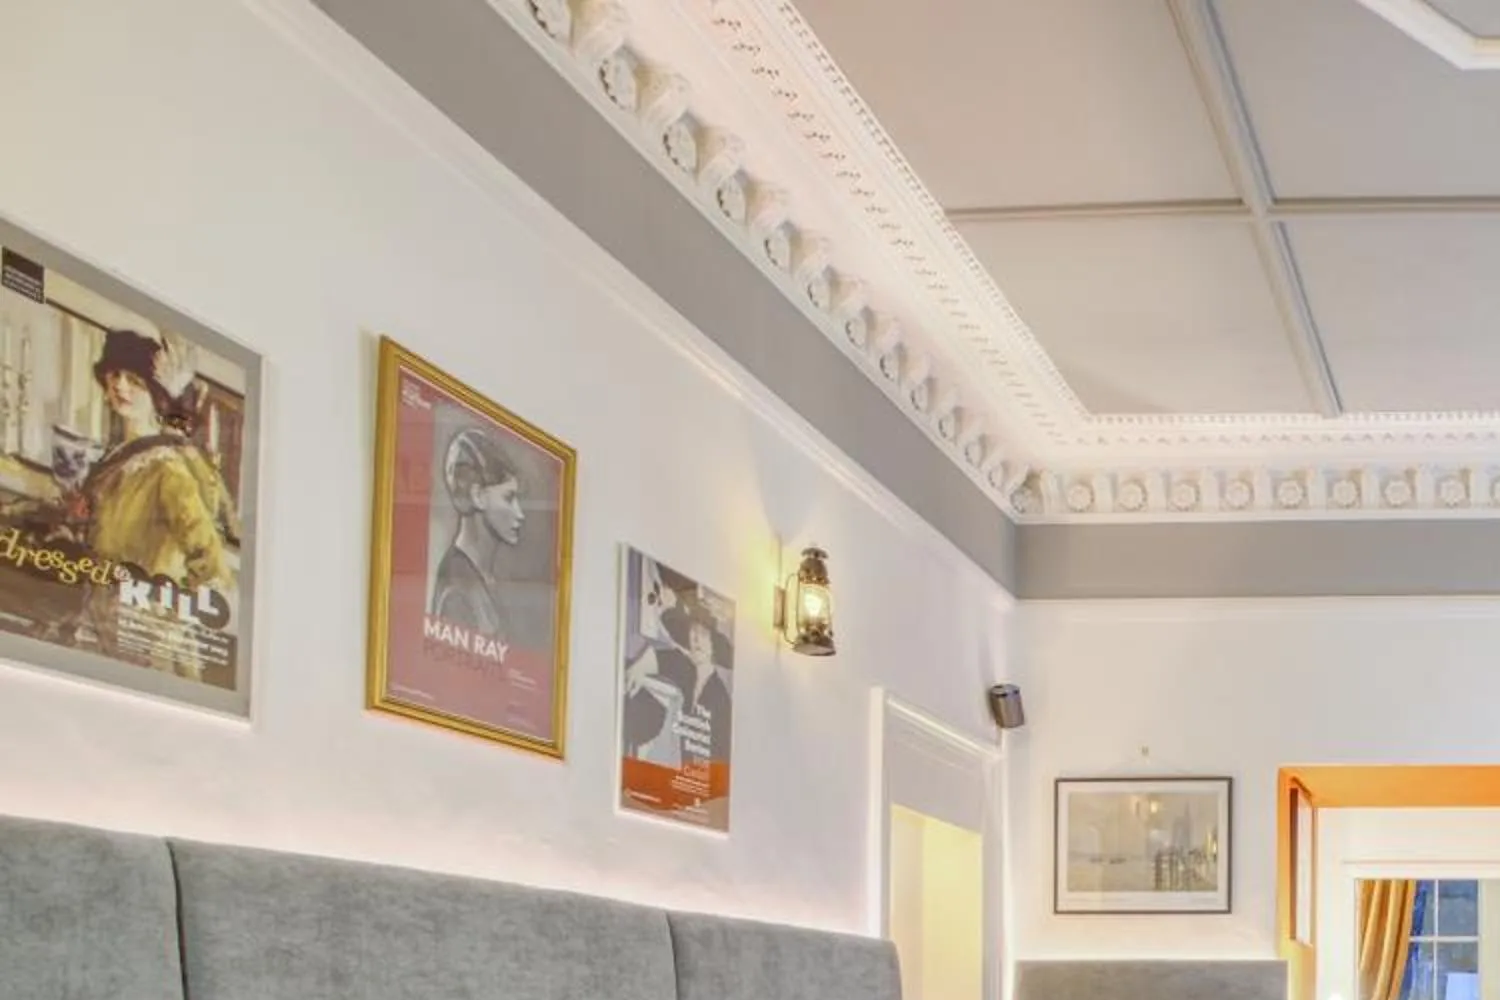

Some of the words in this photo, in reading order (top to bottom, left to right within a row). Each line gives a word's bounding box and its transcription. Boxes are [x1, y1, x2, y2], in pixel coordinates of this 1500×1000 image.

[0, 527, 112, 585] dressed
[423, 616, 470, 650] MAN
[474, 634, 509, 664] RAY
